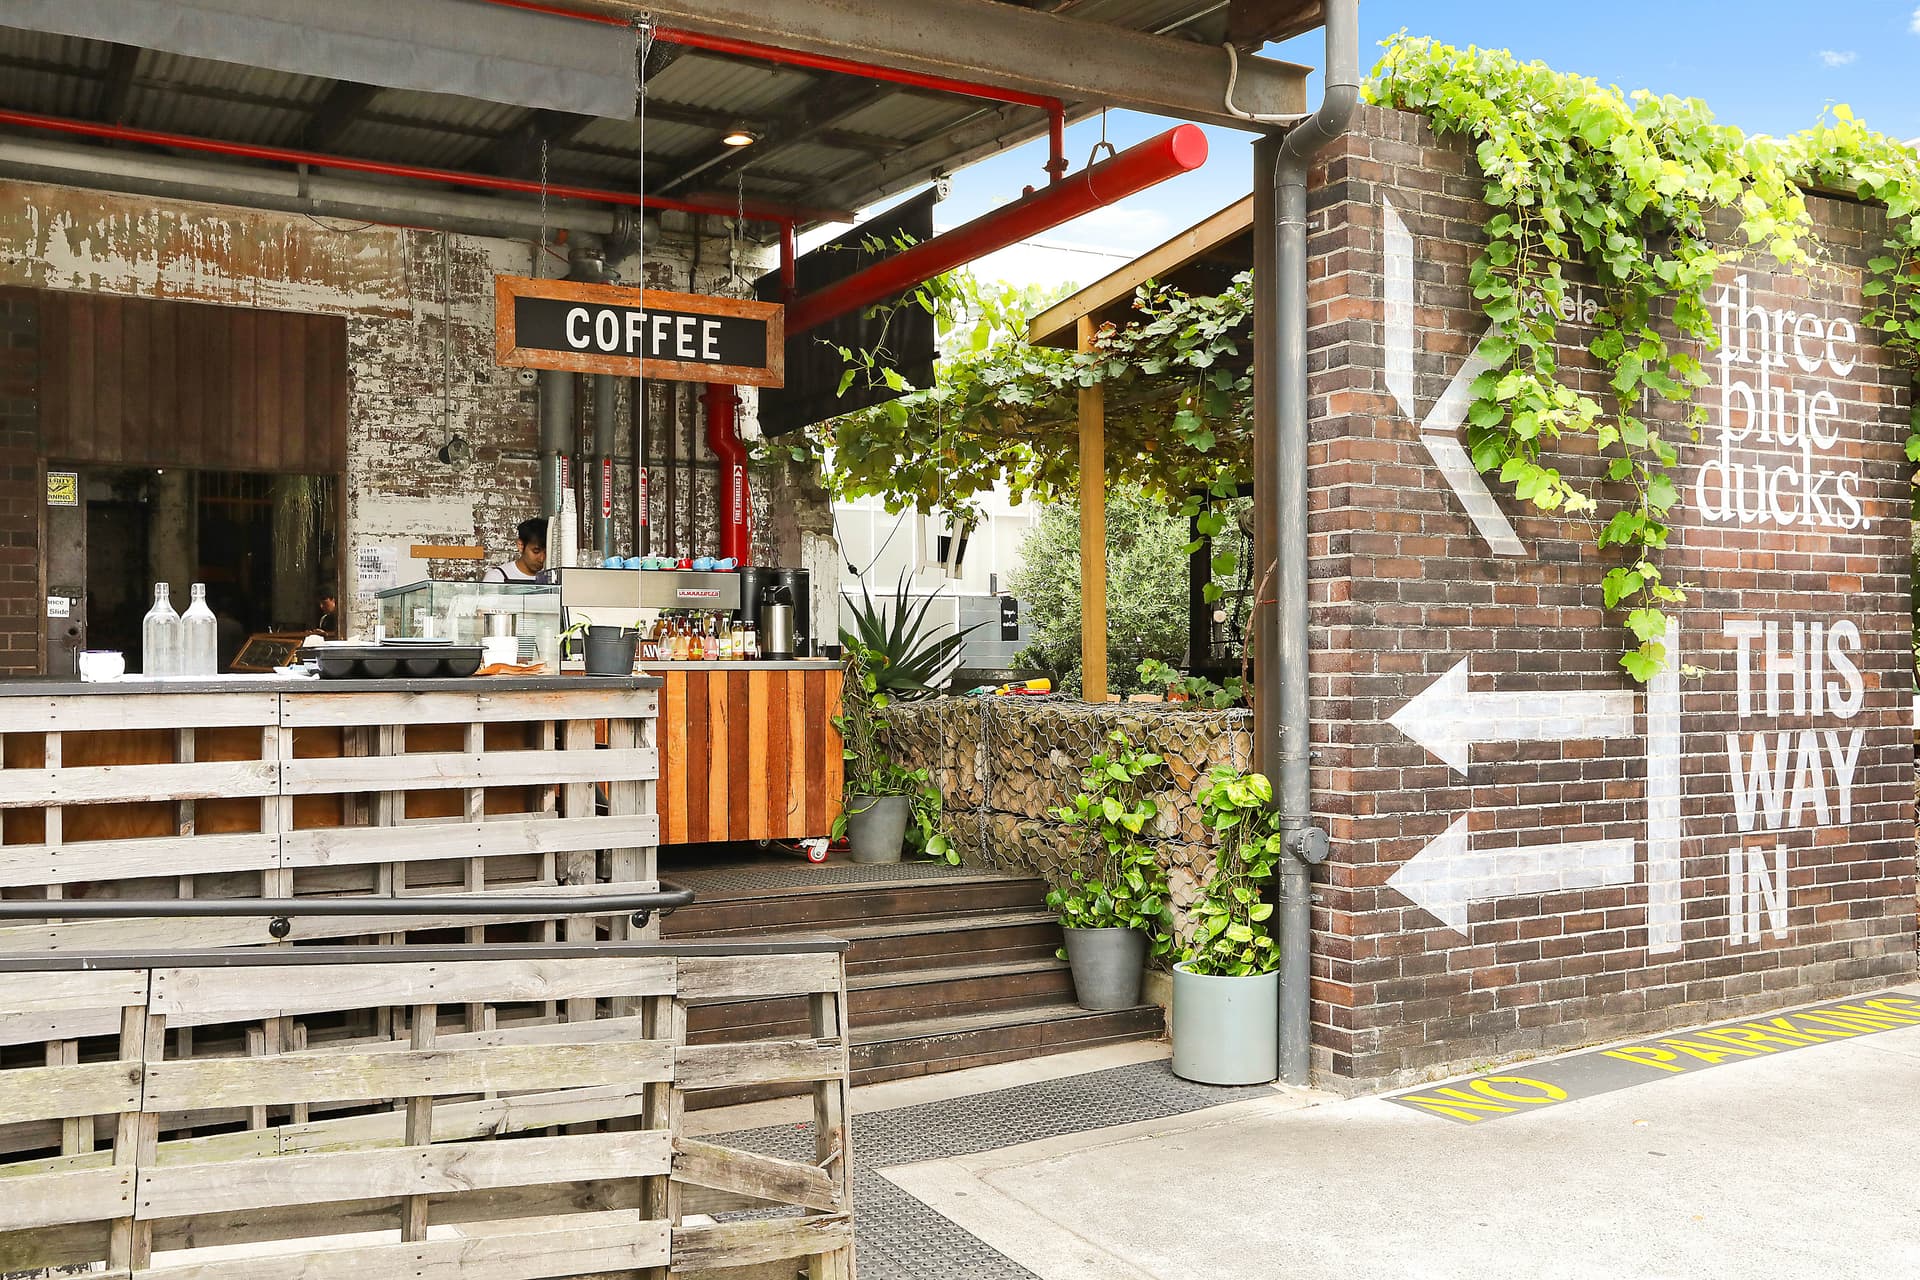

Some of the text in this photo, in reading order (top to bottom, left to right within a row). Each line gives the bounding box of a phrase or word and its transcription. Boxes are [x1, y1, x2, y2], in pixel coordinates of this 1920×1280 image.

[566, 307, 722, 360] COFFEE
[1714, 274, 1857, 377] three
[1715, 352, 1840, 449] blue
[1695, 440, 1871, 530] ducks.
[1723, 619, 1865, 720] THIS
[1726, 730, 1865, 832] WAY
[1728, 843, 1788, 946] IN
[1401, 1076, 1568, 1122] NO
